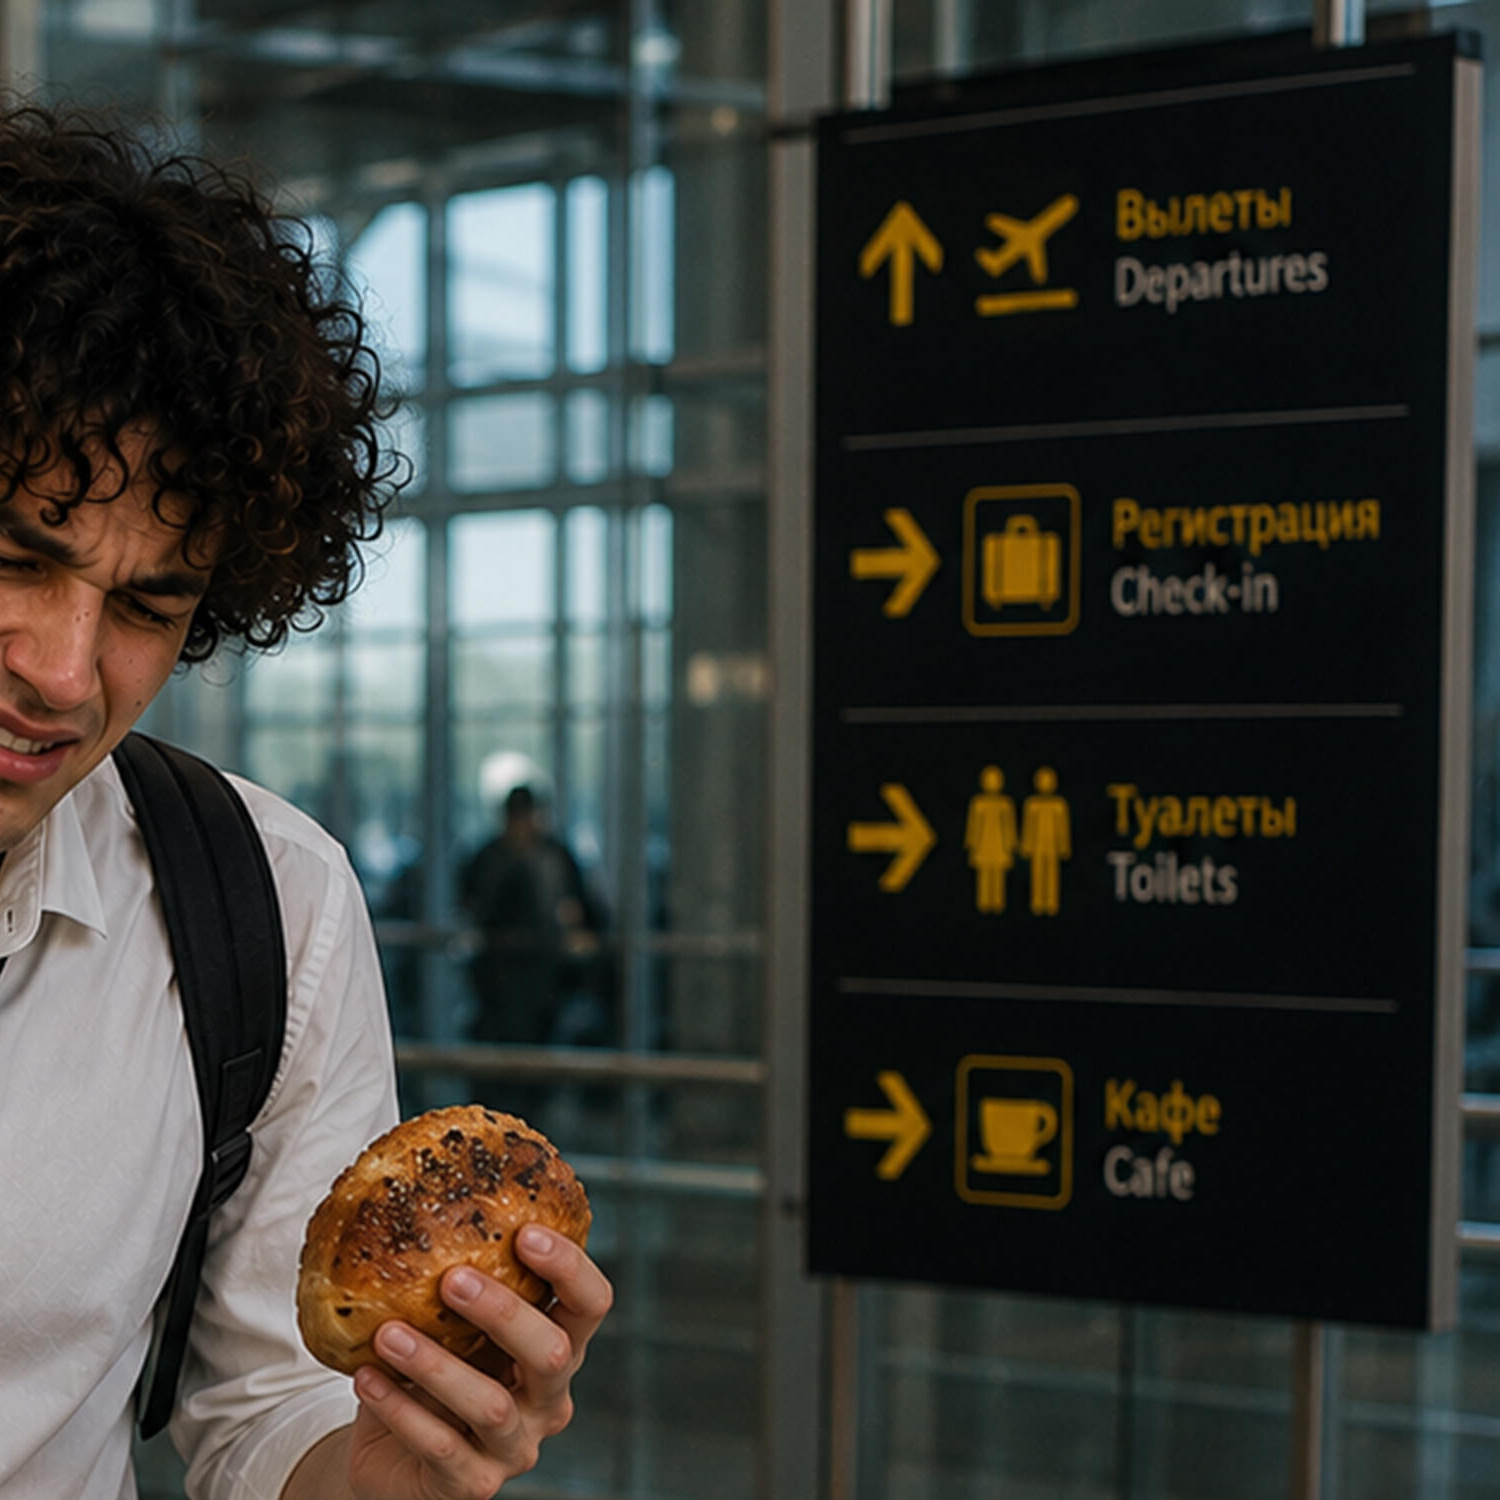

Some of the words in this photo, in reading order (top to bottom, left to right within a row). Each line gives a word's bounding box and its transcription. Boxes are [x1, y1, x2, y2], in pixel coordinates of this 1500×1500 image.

[1116, 187, 1292, 241] Вылеты
[1115, 250, 1329, 314] Departures
[1113, 498, 1381, 556] Регистрация
[1110, 562, 1279, 617] Check-in
[1107, 784, 1297, 848] Туалеты
[1107, 851, 1238, 905] Toilets
[1105, 1079, 1222, 1146] Кафе
[1103, 1145, 1195, 1201] Cafe
